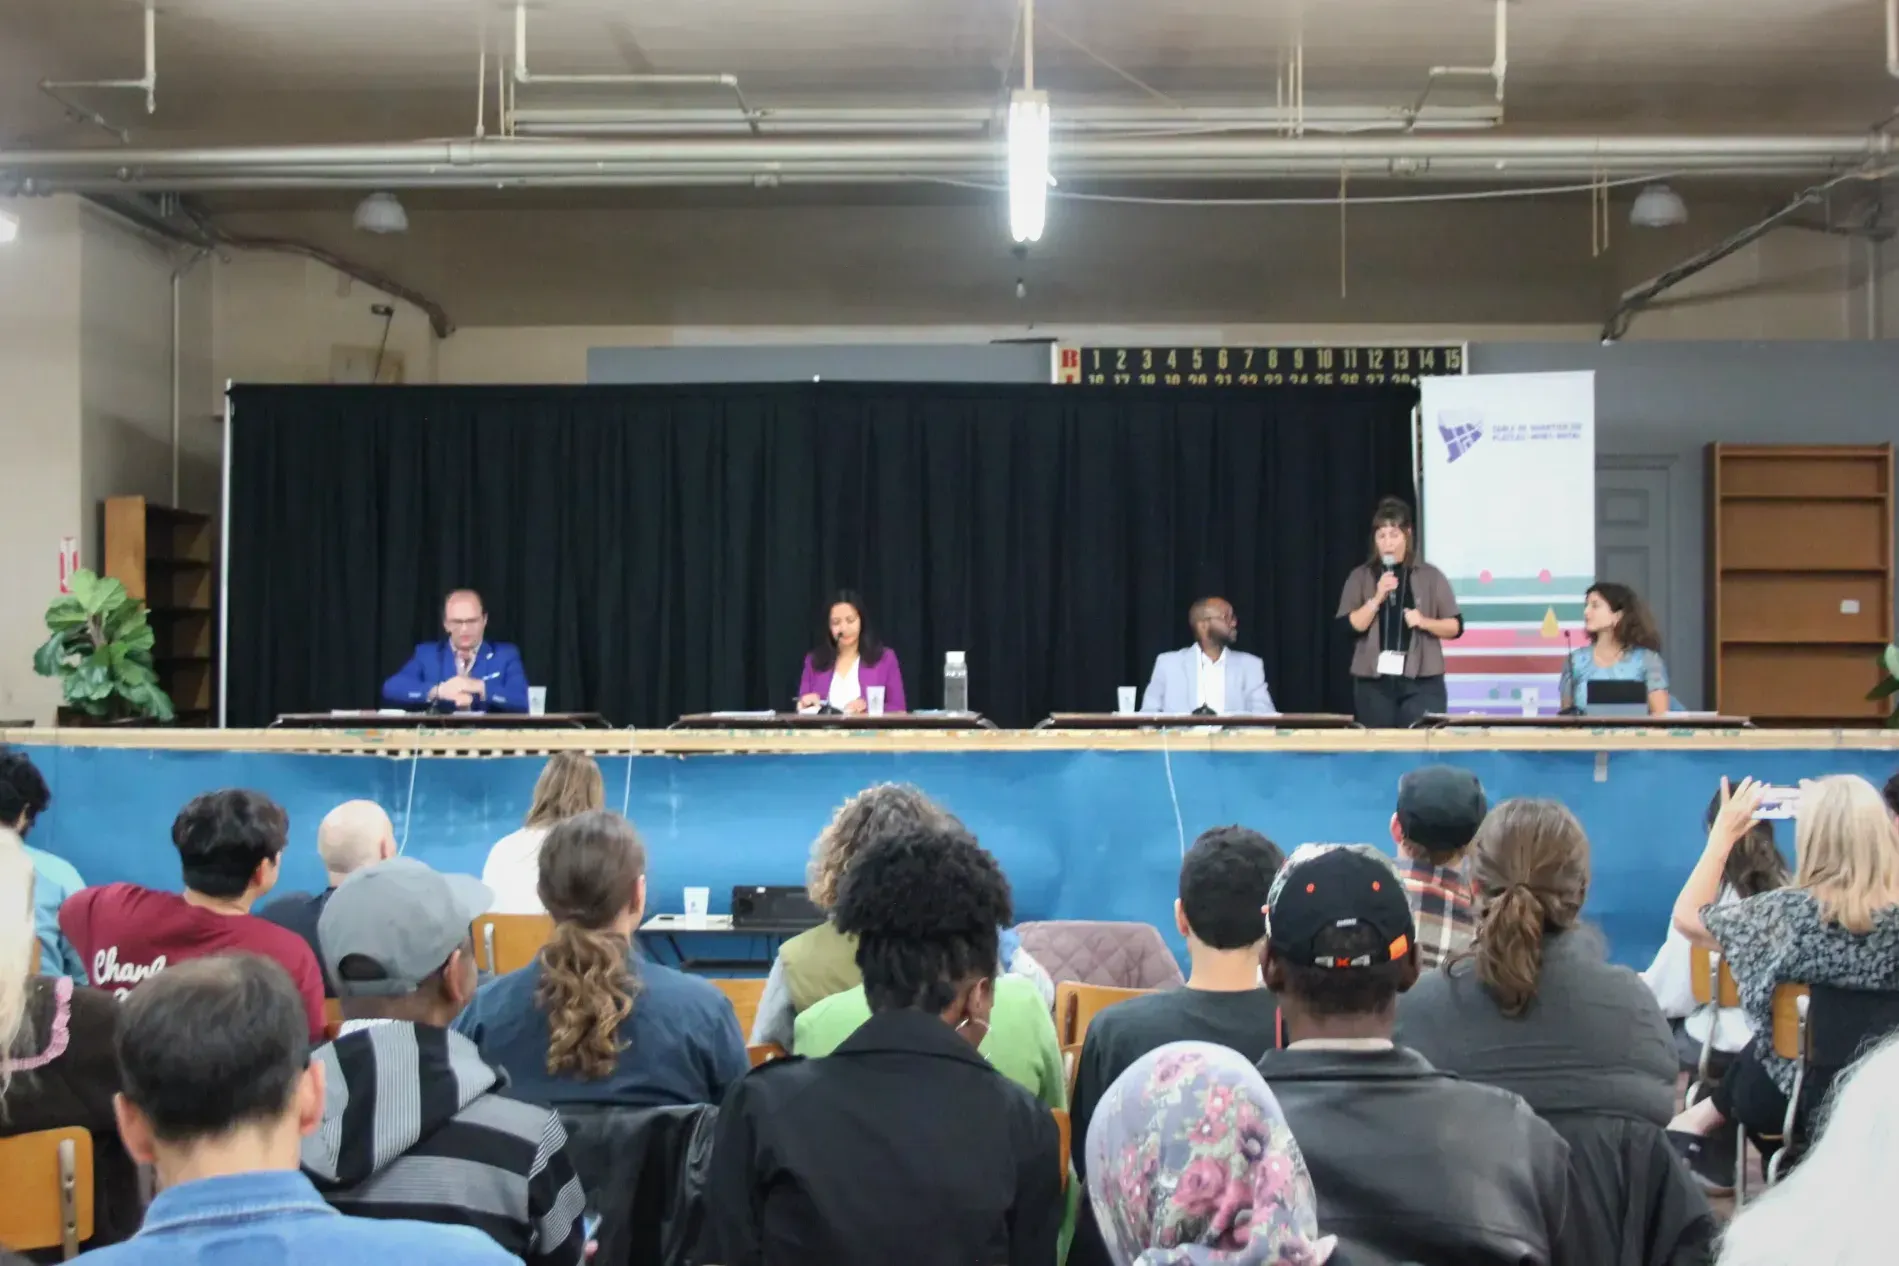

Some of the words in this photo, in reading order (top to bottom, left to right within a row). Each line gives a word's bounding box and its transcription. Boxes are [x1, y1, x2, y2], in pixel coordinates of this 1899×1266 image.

[1062, 349, 1078, 368] B
[1093, 349, 1100, 370] 1
[1116, 349, 1127, 370] 2
[1142, 349, 1152, 369] 3
[1166, 349, 1176, 369] 4
[1192, 349, 1202, 370] 5
[1218, 349, 1228, 369] 6
[1243, 349, 1254, 369] 7
[1268, 348, 1278, 369] 8
[1294, 348, 1304, 369] 9
[1317, 348, 1333, 369] 10
[1343, 349, 1357, 369] 11
[1368, 349, 1384, 369] 12
[1393, 349, 1409, 369] 13
[1418, 349, 1434, 369] 14
[1444, 349, 1461, 369] 15
